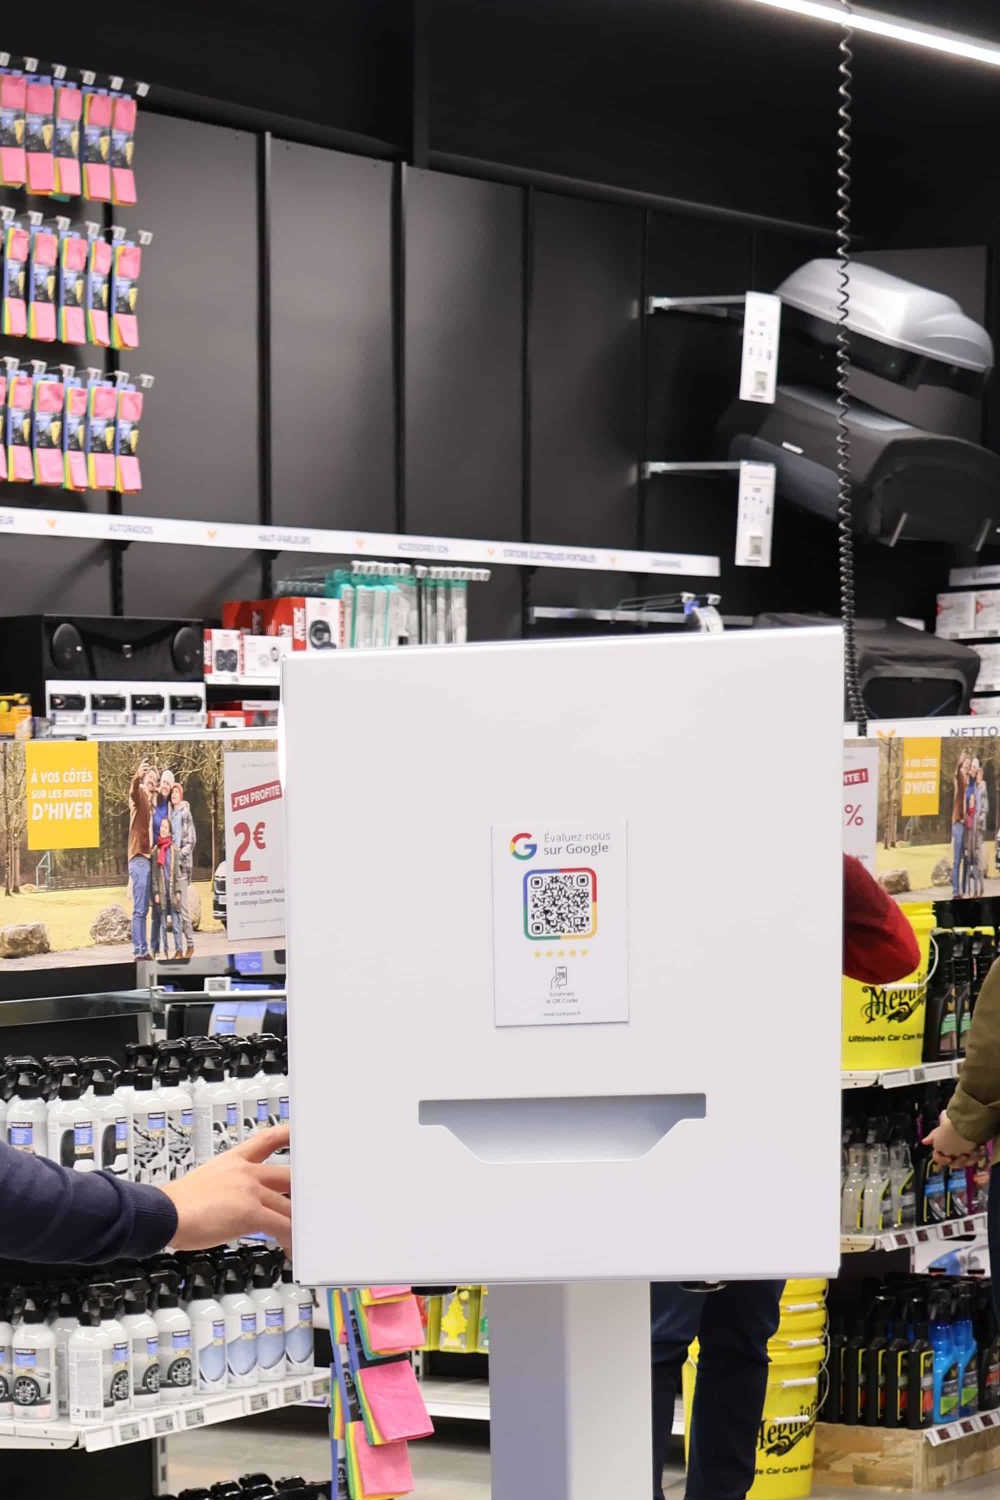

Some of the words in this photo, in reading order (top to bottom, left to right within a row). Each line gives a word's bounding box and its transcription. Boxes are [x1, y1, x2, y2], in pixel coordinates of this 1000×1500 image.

[30, 767, 39, 784] À
[40, 771, 60, 784] VOS
[62, 767, 93, 784] CÔTÉS
[31, 789, 46, 799] SUR
[48, 788, 62, 799] LES
[63, 788, 93, 798] ROUTES
[232, 793, 249, 808] J'EN
[250, 784, 281, 804] PROFITE
[31, 801, 93, 821] D'HIVER
[544, 832, 611, 843] Évaluez-nous
[543, 846, 563, 855] sur
[566, 842, 609, 856] Google
[848, 1034, 885, 1043] Ultimate
[887, 1033, 901, 1041] Car
[766, 1467, 781, 1475] Car
